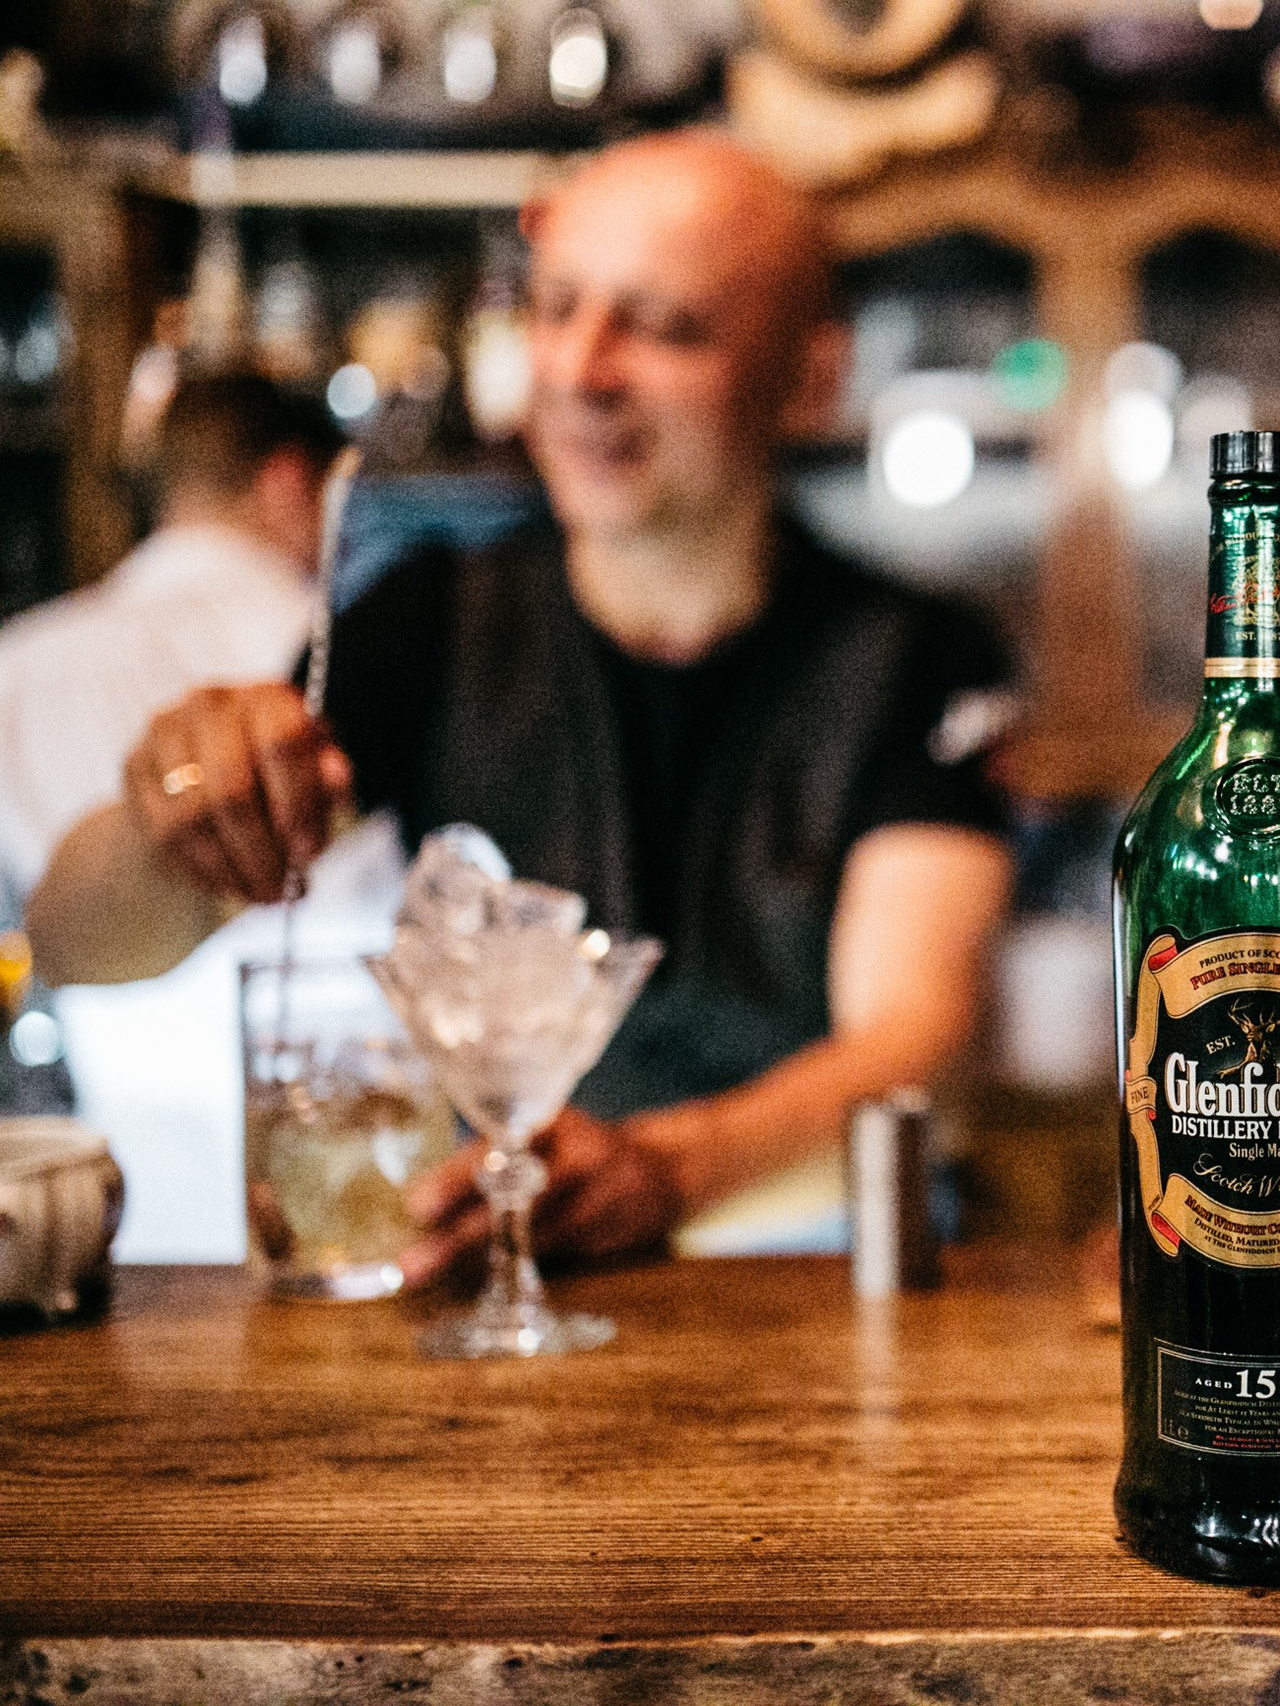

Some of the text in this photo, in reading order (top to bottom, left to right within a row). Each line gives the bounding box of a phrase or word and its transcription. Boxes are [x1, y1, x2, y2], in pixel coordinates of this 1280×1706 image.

[1200, 951, 1245, 968] PRODUCT
[1248, 950, 1261, 958] OF
[1190, 968, 1227, 991] PURE
[1229, 962, 1280, 978] SINGLE
[1206, 1034, 1236, 1055] EST.
[1131, 1086, 1149, 1104] FINE
[1172, 1114, 1272, 1140] DISTILLERY
[1229, 1143, 1264, 1160] Single
[1193, 1153, 1254, 1195] Scotch
[1236, 1236, 1280, 1247] MATURED
[1195, 1377, 1233, 1389] AGED
[1235, 1369, 1276, 1399] 15
